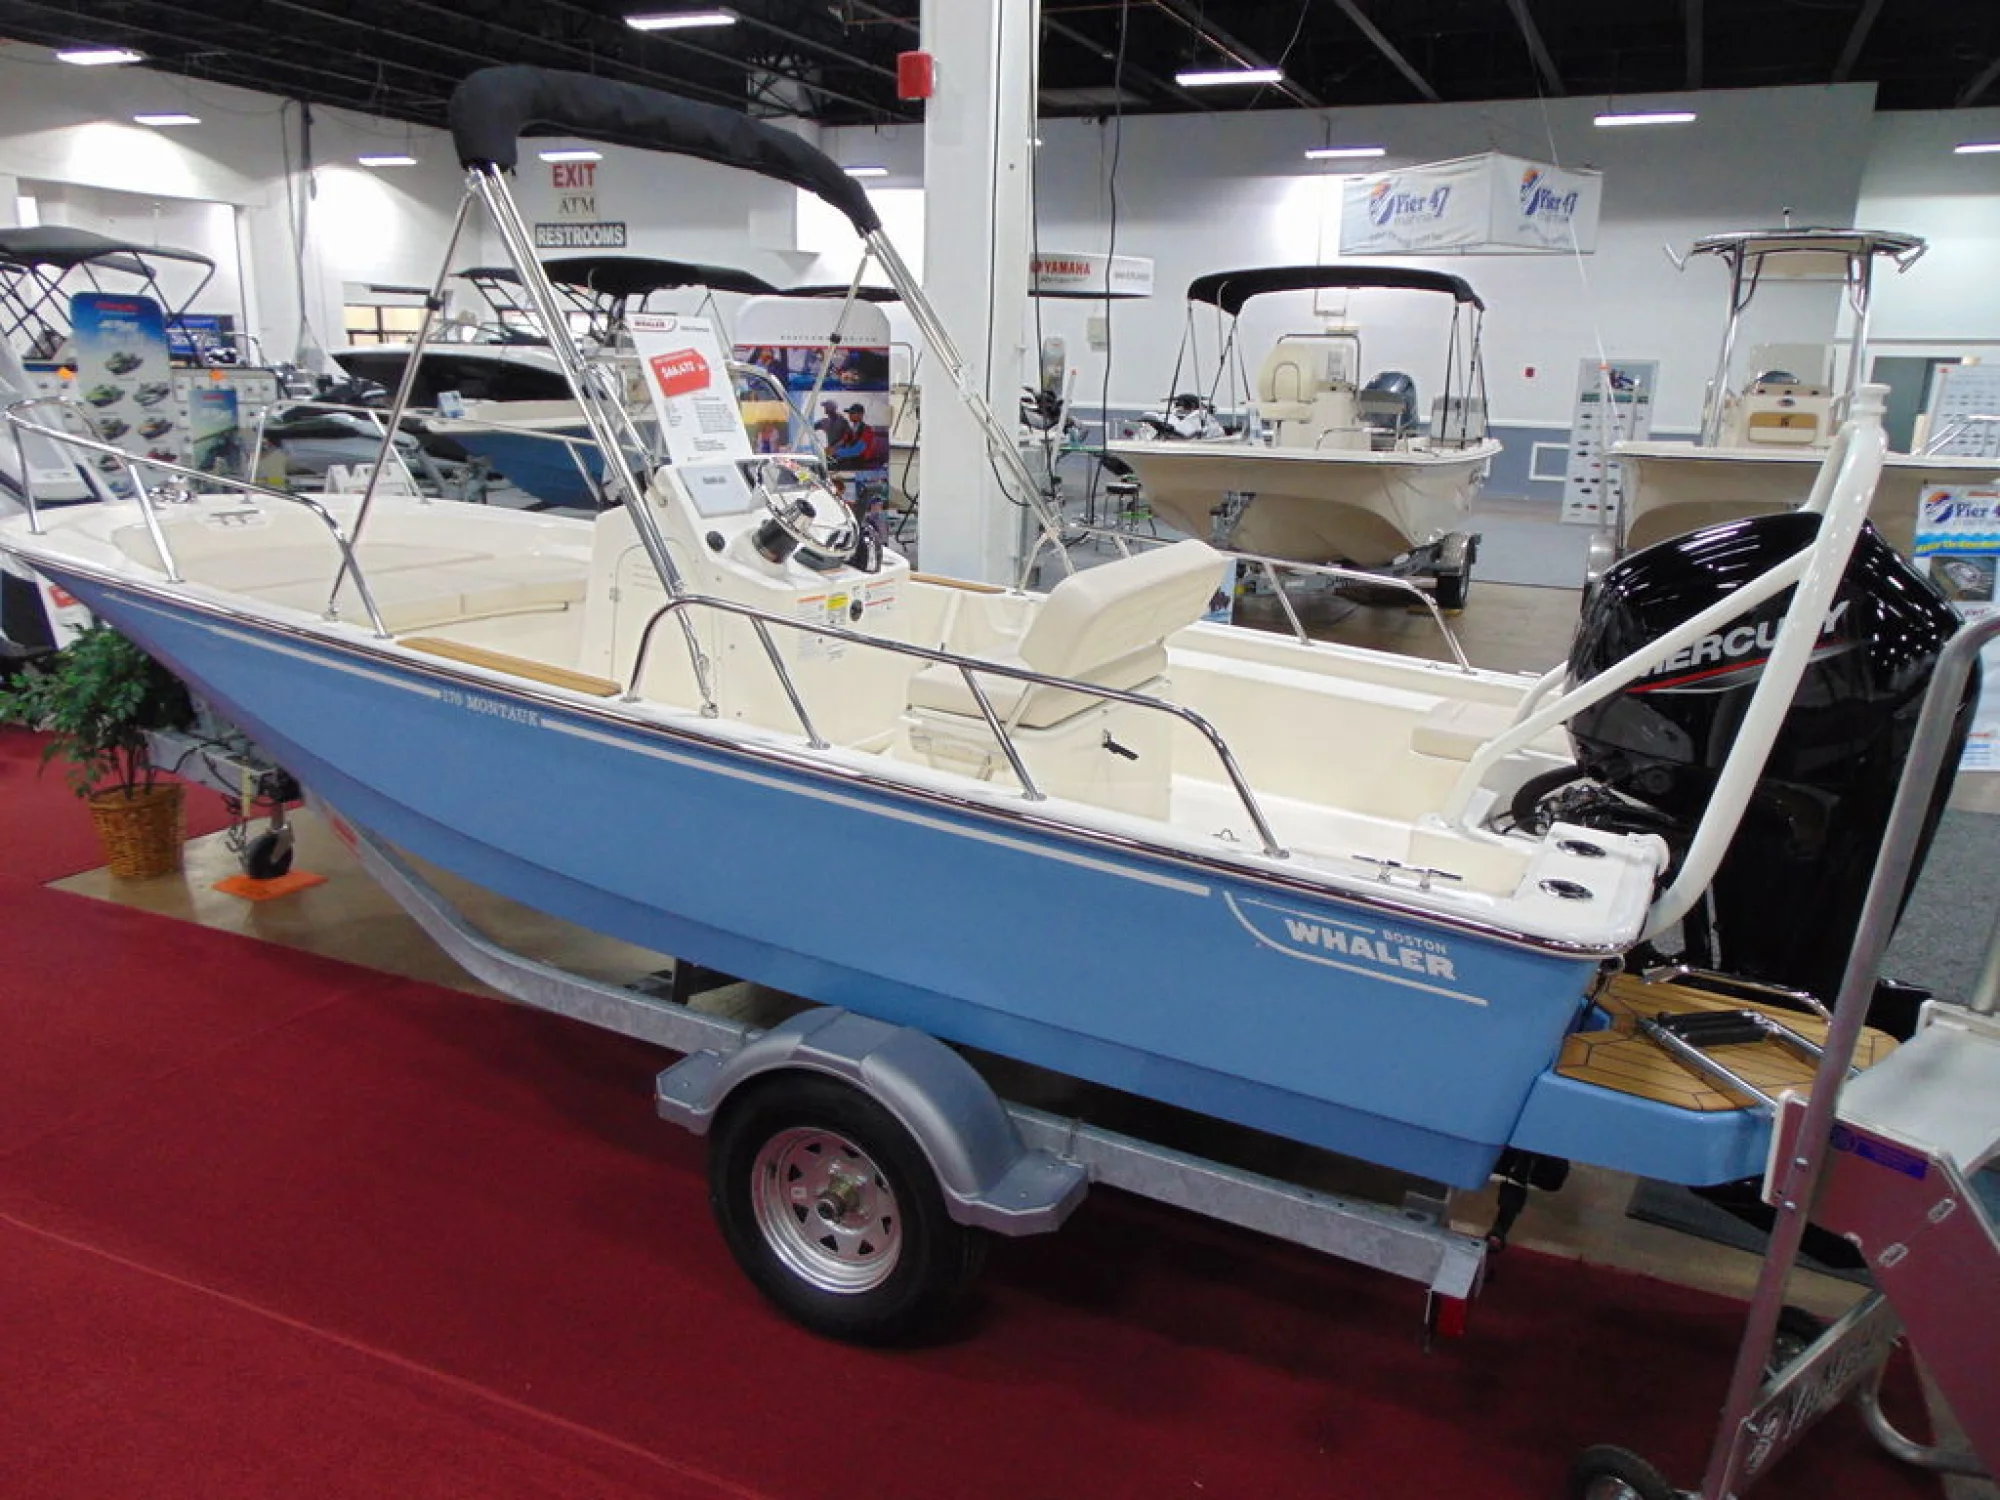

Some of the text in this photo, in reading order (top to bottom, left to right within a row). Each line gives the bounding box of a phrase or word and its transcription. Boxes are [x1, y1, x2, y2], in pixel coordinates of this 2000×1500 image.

[553, 163, 596, 188] EXIT
[558, 196, 595, 214] ATM
[1395, 185, 1451, 218] Pier 47
[1539, 188, 1562, 210] Pier
[536, 225, 623, 245] RESTROOMS
[1044, 260, 1091, 276] YAMAHA
[1956, 502, 1989, 517] Pier
[1638, 600, 1851, 677] ERCUY
[466, 695, 538, 727] MONTAUK
[1284, 918, 1457, 981] WHALER
[1383, 929, 1447, 954] BOSTON
